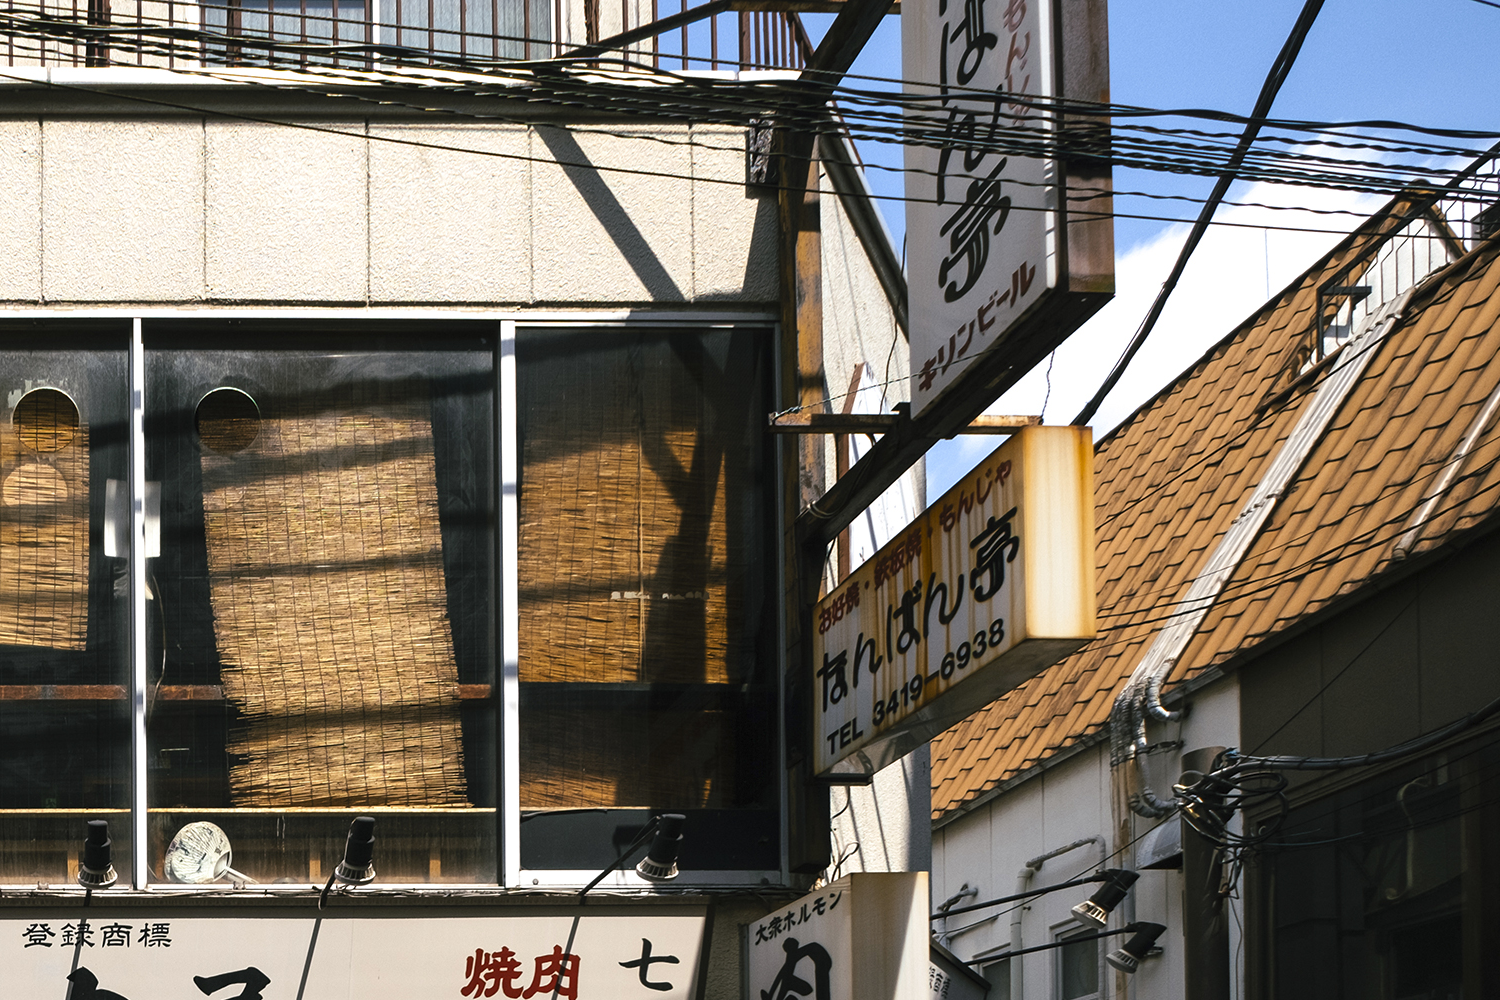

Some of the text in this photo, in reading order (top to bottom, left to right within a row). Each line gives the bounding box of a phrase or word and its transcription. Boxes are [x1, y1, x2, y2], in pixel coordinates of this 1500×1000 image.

[918, 261, 1036, 392] キリンビール
[816, 506, 1020, 713] なんばん亭
[827, 618, 1005, 755] TEL 3419-6938
[21, 921, 173, 949] 登録商標
[755, 889, 843, 946] 大衆ホルモン
